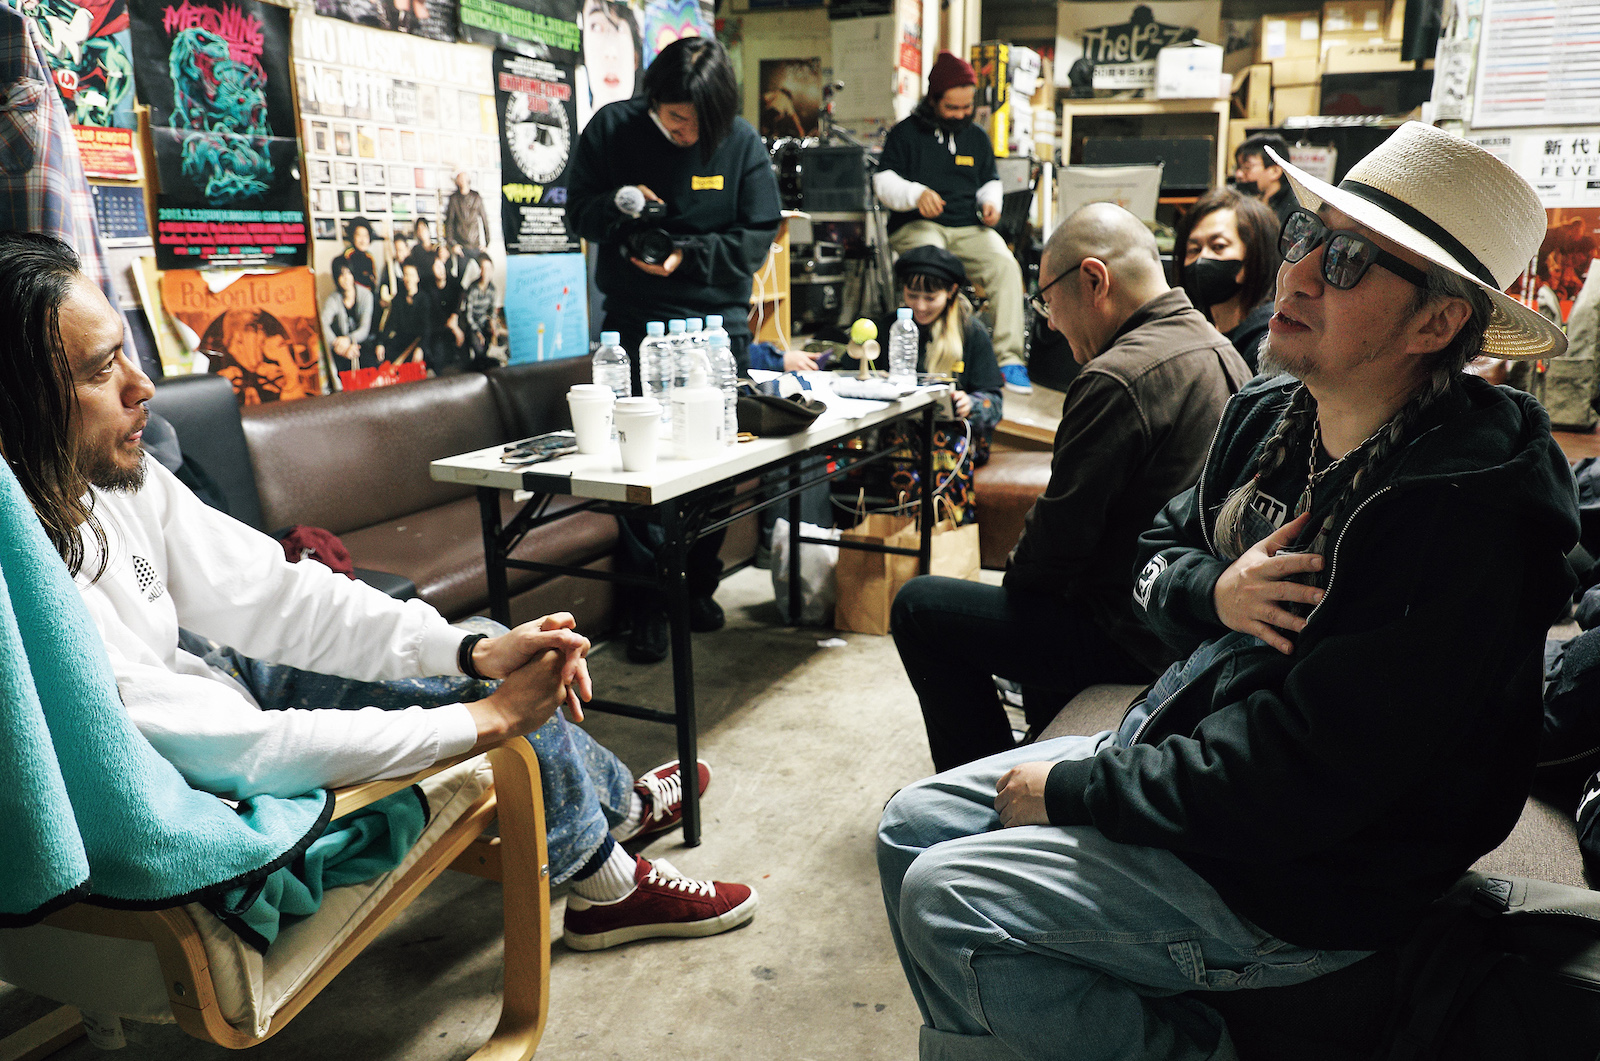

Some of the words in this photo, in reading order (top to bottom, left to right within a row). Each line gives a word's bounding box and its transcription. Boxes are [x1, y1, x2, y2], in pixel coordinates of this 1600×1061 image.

[302, 17, 337, 63] NO
[337, 26, 415, 77] MUSIC,
[415, 42, 443, 80] NO
[445, 47, 489, 87] LIFE
[1544, 138, 1600, 155] 新代
[180, 281, 249, 310] Poison
[249, 282, 297, 307] Idea
